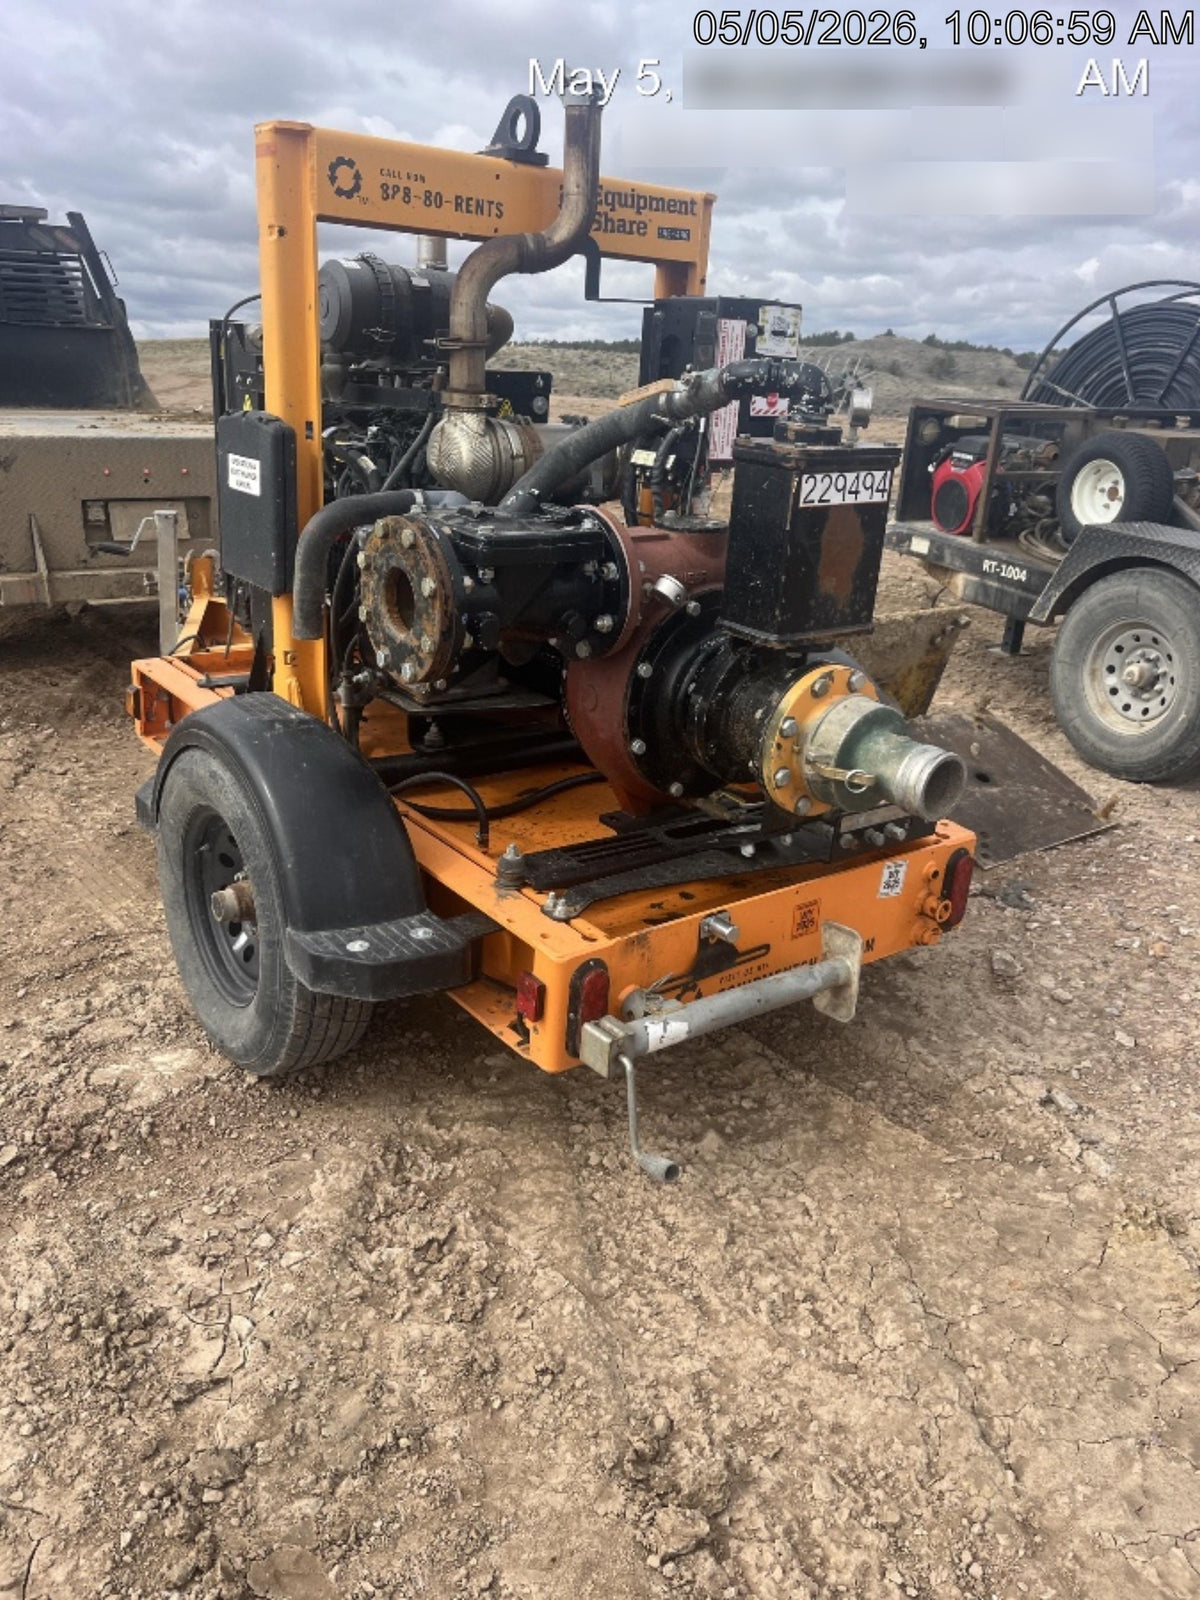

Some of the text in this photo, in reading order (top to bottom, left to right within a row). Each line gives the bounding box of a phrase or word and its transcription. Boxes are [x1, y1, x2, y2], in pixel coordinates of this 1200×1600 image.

[591, 211, 648, 237] Share
[802, 470, 888, 504] 229494
[982, 559, 1028, 583] RT-1004
